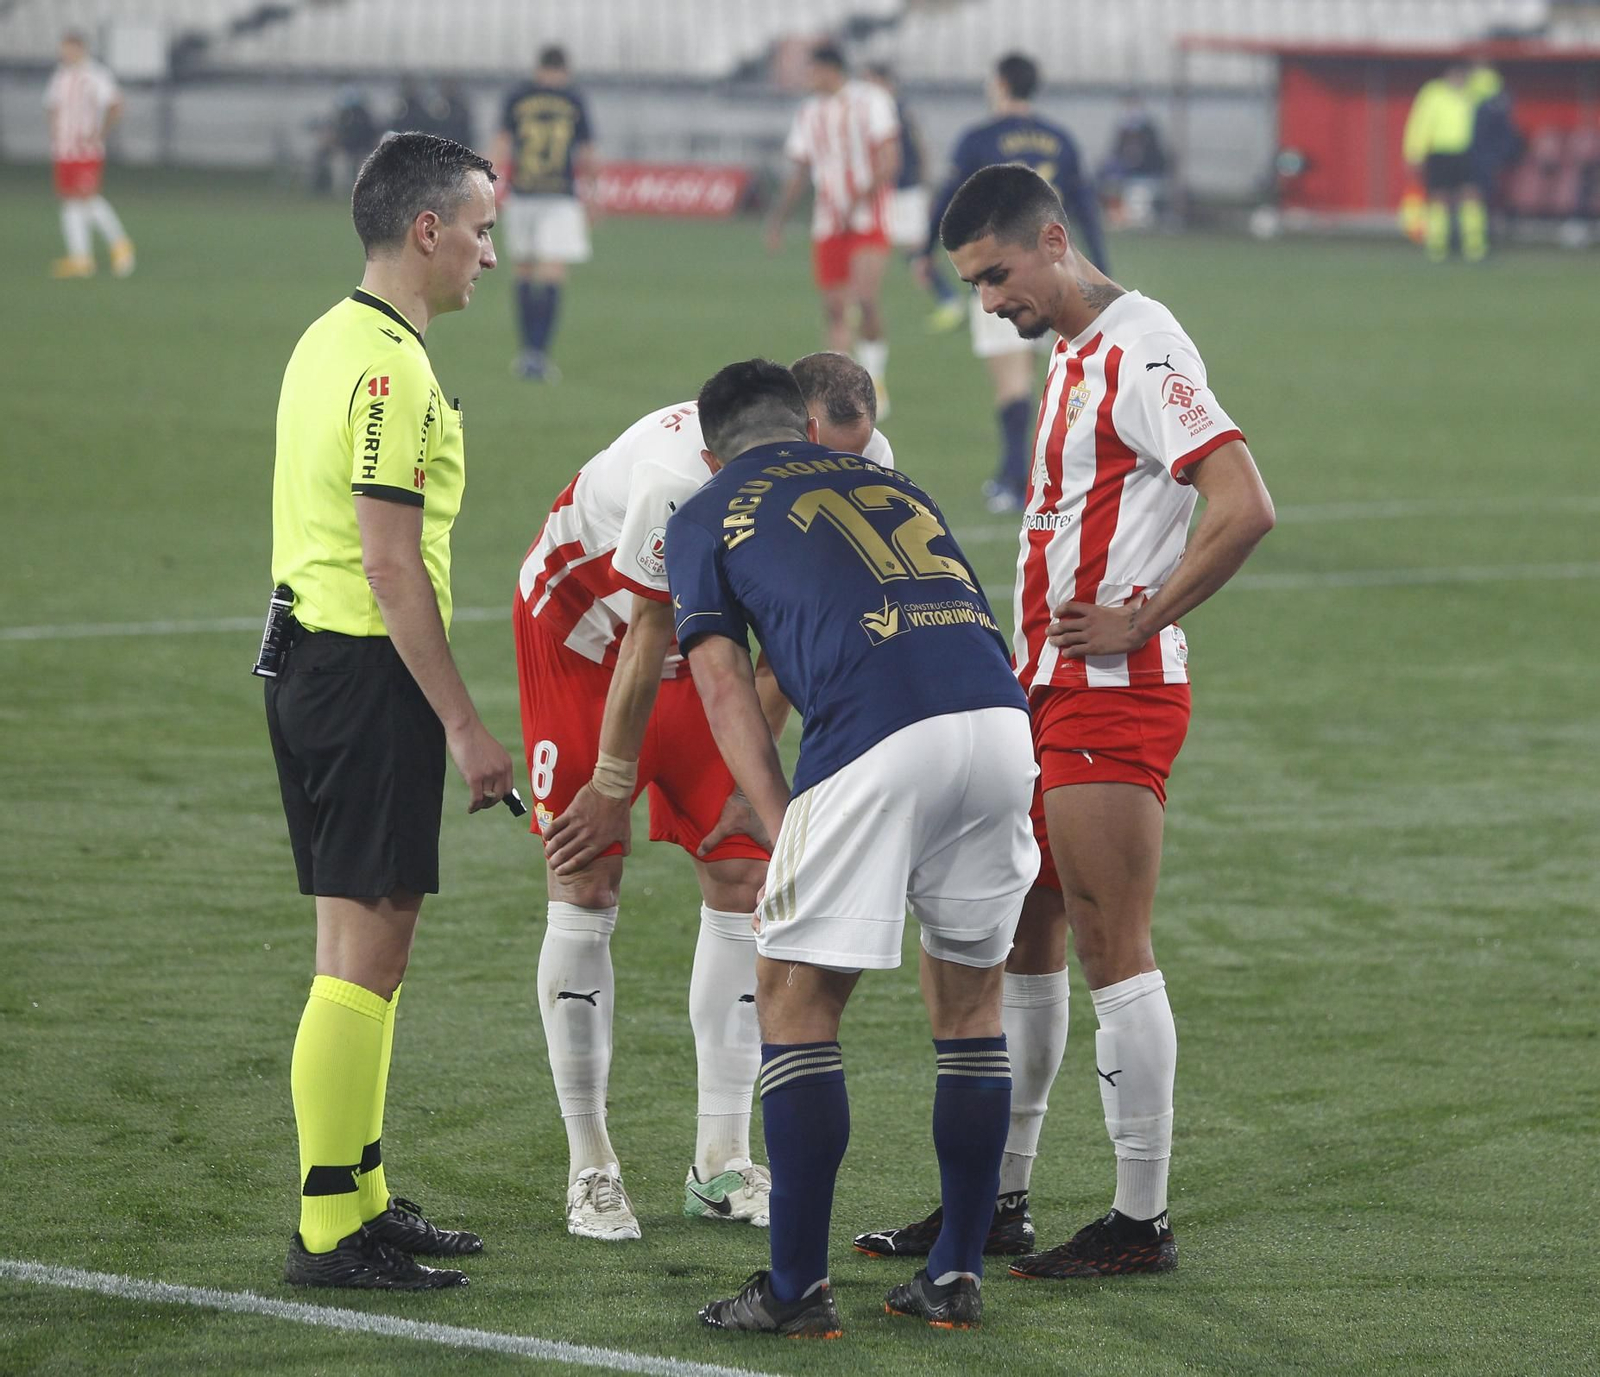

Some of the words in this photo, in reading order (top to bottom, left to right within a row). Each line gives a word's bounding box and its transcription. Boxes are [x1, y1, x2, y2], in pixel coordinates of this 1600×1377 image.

[362, 401, 385, 480] WÜRTH
[417, 389, 437, 463] RTH
[1178, 404, 1207, 427] PDR
[723, 480, 774, 550] FACU
[787, 485, 978, 593] 12
[645, 556, 663, 568] COPA
[904, 600, 974, 612] CONSTRUCCIONES
[906, 608, 976, 627] VICTORINO
[532, 739, 559, 800] 8
